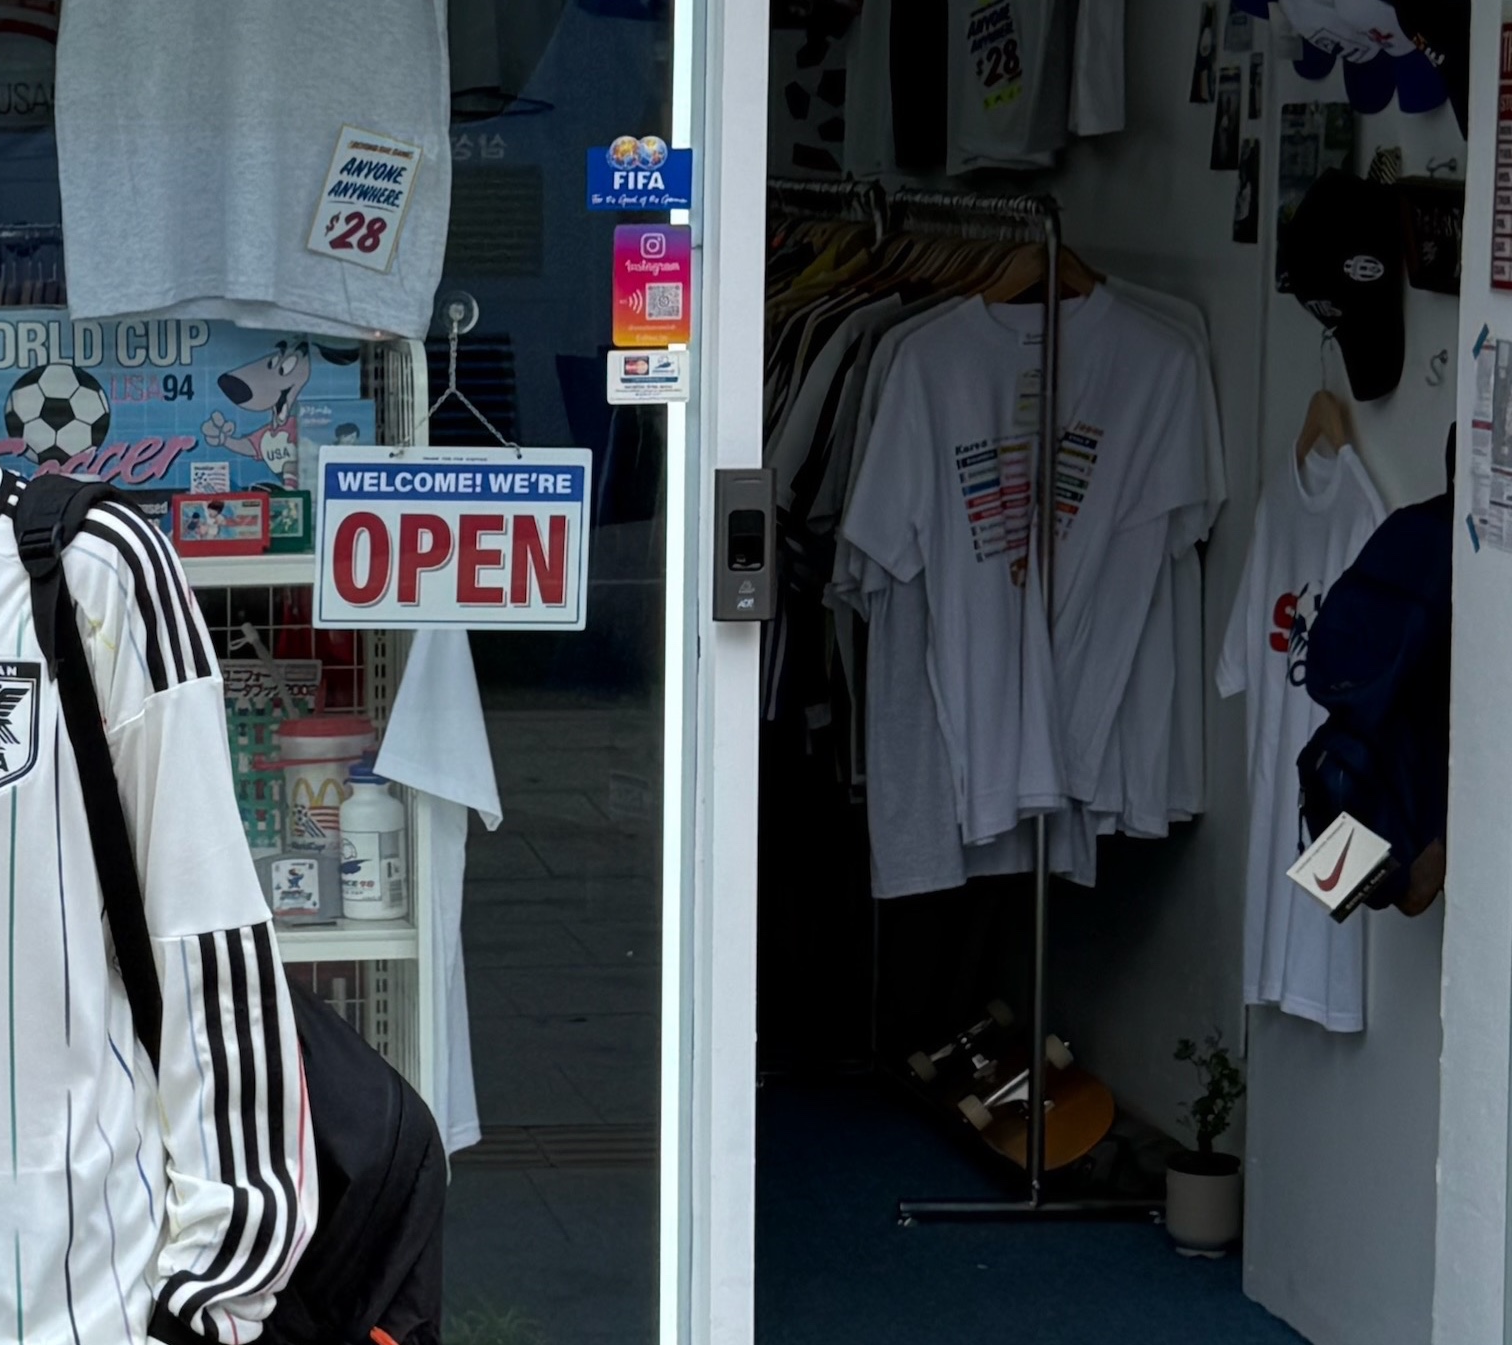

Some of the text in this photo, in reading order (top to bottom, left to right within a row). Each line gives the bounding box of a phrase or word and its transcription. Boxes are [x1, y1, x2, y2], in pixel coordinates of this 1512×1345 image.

[338, 156, 408, 185] ANYONE
[613, 170, 665, 191] FIFA
[327, 179, 405, 209] ANYWHERE
[625, 258, 680, 277] Instagram
[115, 318, 210, 369] CUP
[336, 471, 573, 494] WELCOME! WE'RE
[332, 510, 569, 607] OPEN
